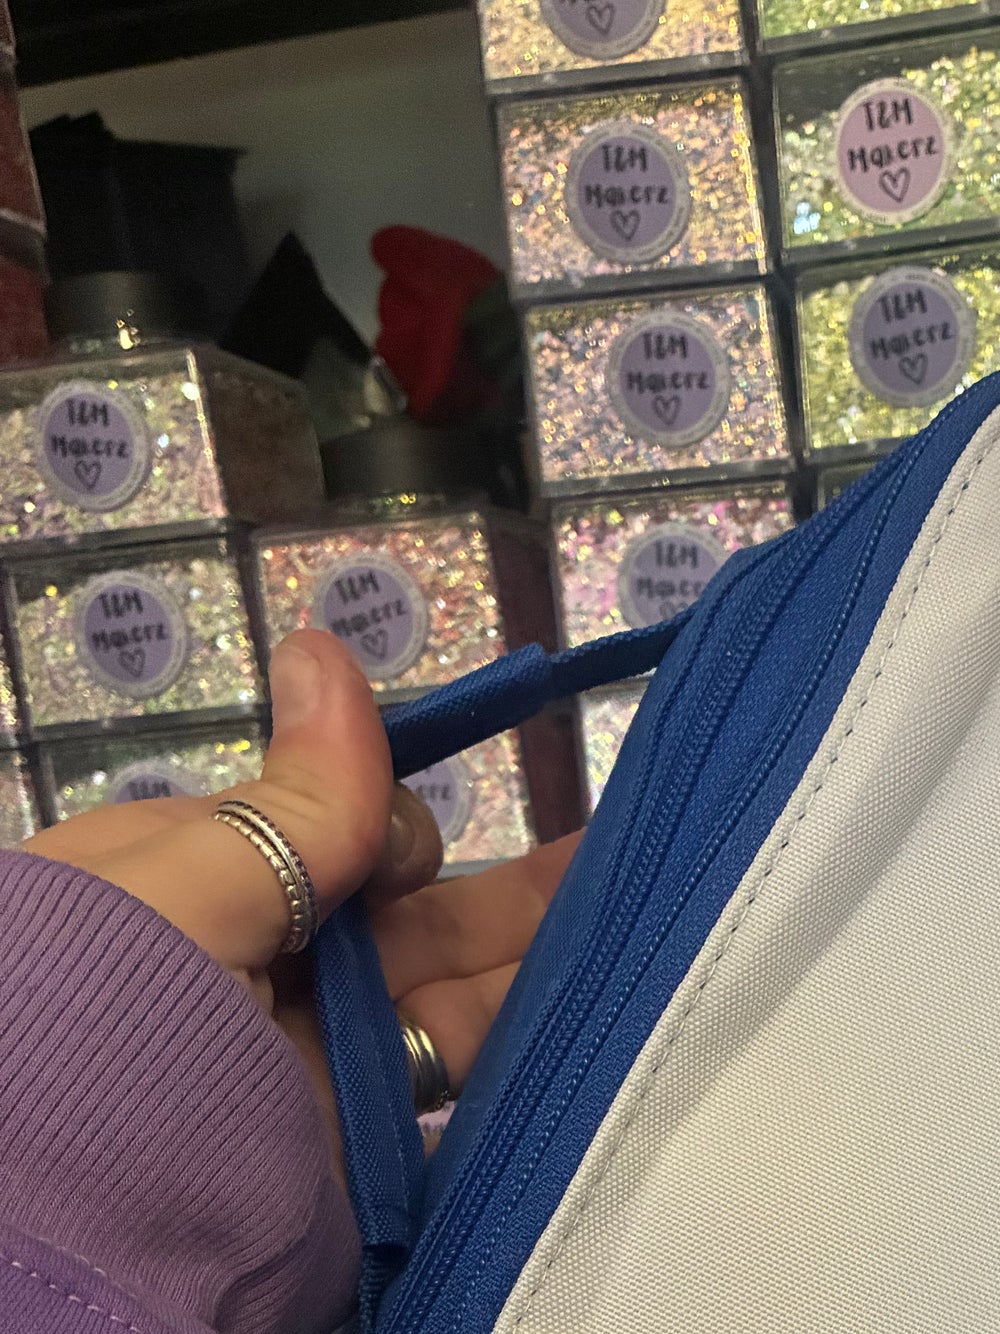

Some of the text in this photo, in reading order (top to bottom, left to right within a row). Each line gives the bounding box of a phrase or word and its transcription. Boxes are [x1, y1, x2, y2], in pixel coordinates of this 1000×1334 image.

[864, 98, 912, 131] T&M
[603, 143, 647, 172] T&M
[848, 135, 938, 173] Makerz
[881, 289, 927, 323] T&M
[643, 332, 688, 361] T&M
